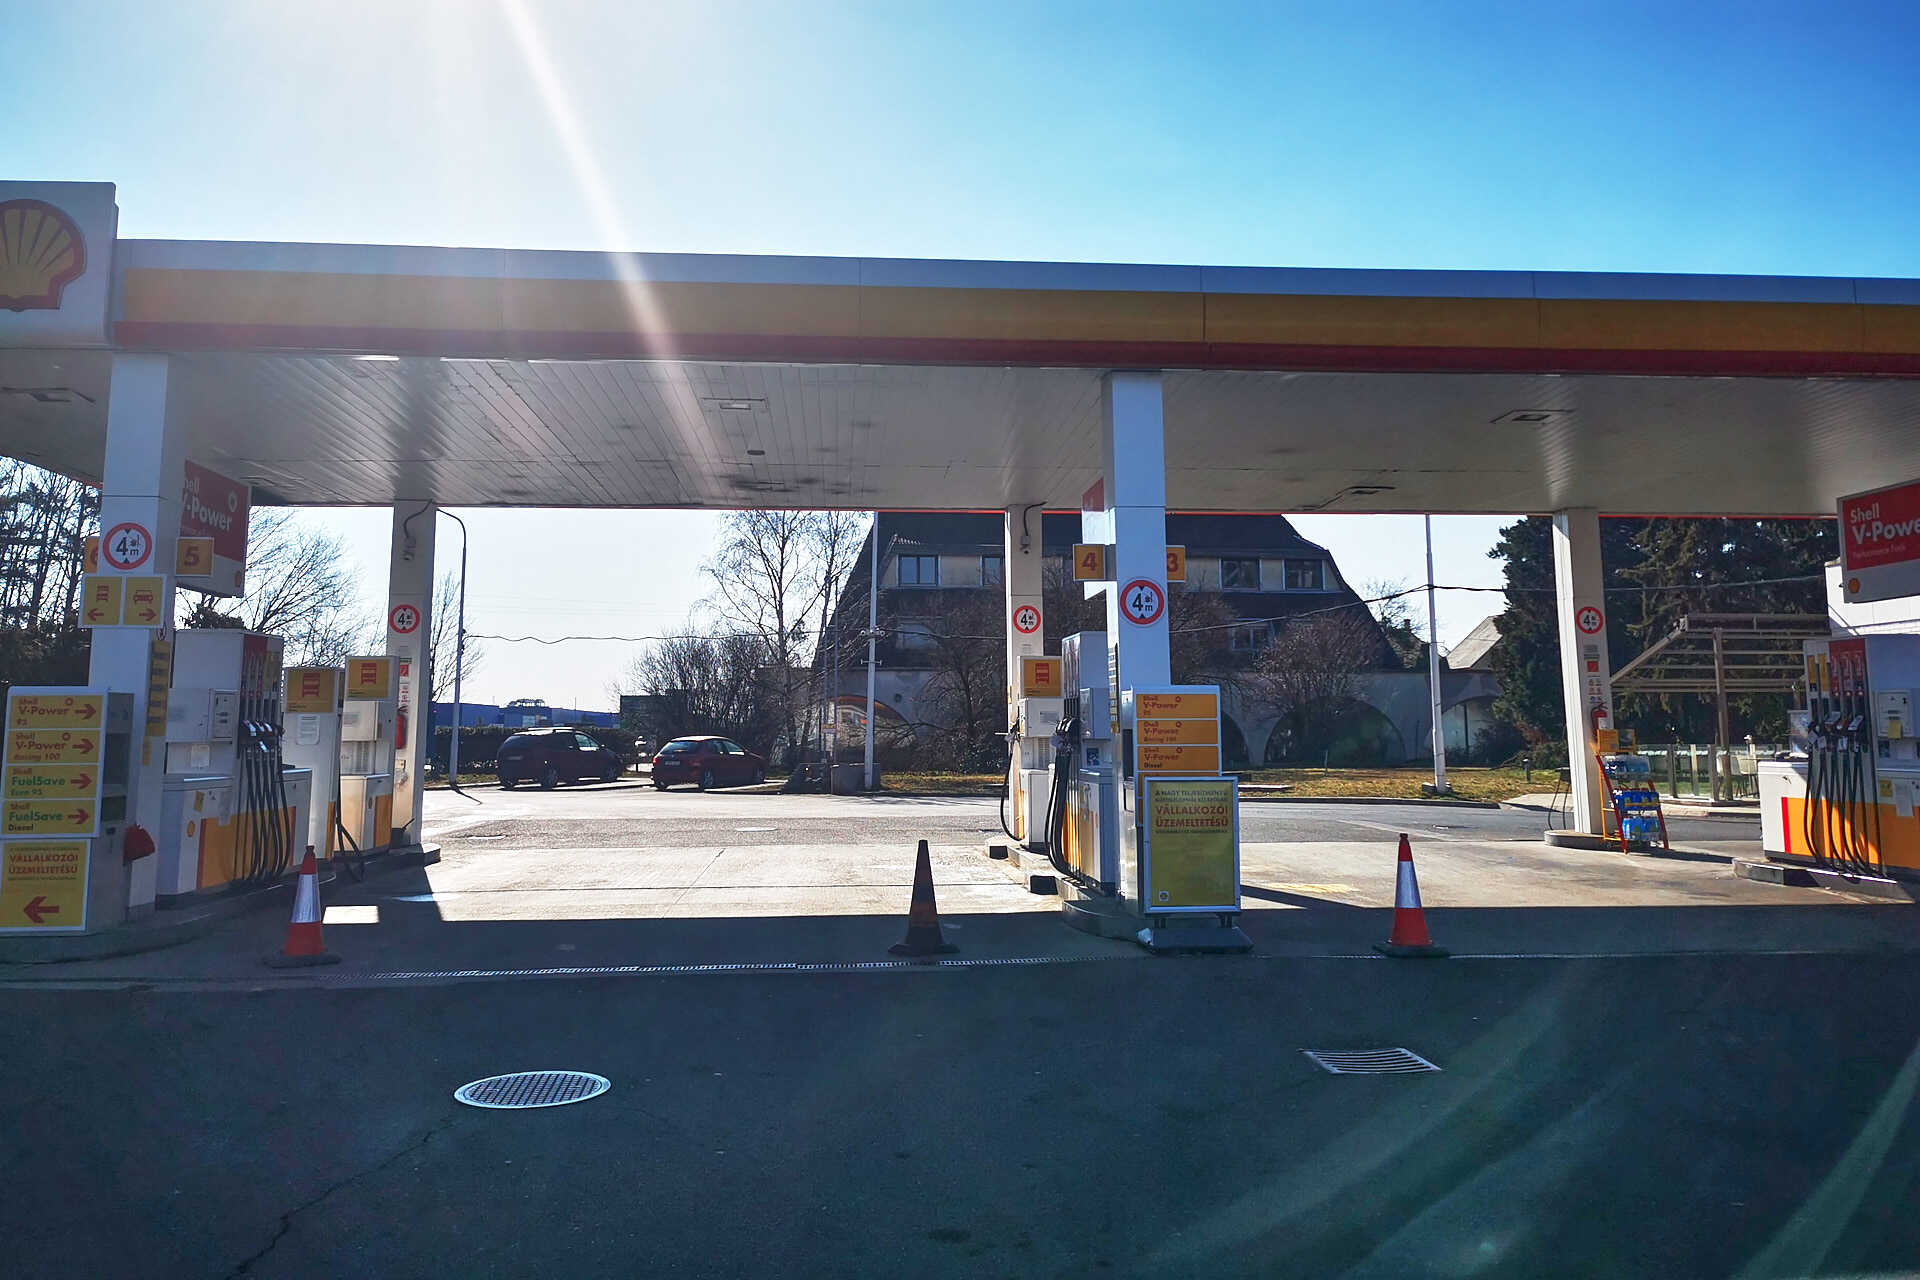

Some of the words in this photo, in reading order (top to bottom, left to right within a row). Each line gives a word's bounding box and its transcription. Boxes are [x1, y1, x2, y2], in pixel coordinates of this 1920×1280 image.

[1850, 502, 1880, 523] Shell
[1852, 519, 1920, 545] V-Powe
[116, 536, 129, 556] 4
[183, 546, 200, 567] 5
[1082, 552, 1097, 571] 4
[1166, 552, 1179, 573] 3
[1132, 593, 1144, 612] 4
[398, 612, 406, 625] 4
[1020, 613, 1028, 626] 4
[1583, 614, 1591, 626] 4
[15, 741, 67, 750] V-Power
[11, 776, 66, 786] FuelSave
[9, 811, 64, 821] FuelSave
